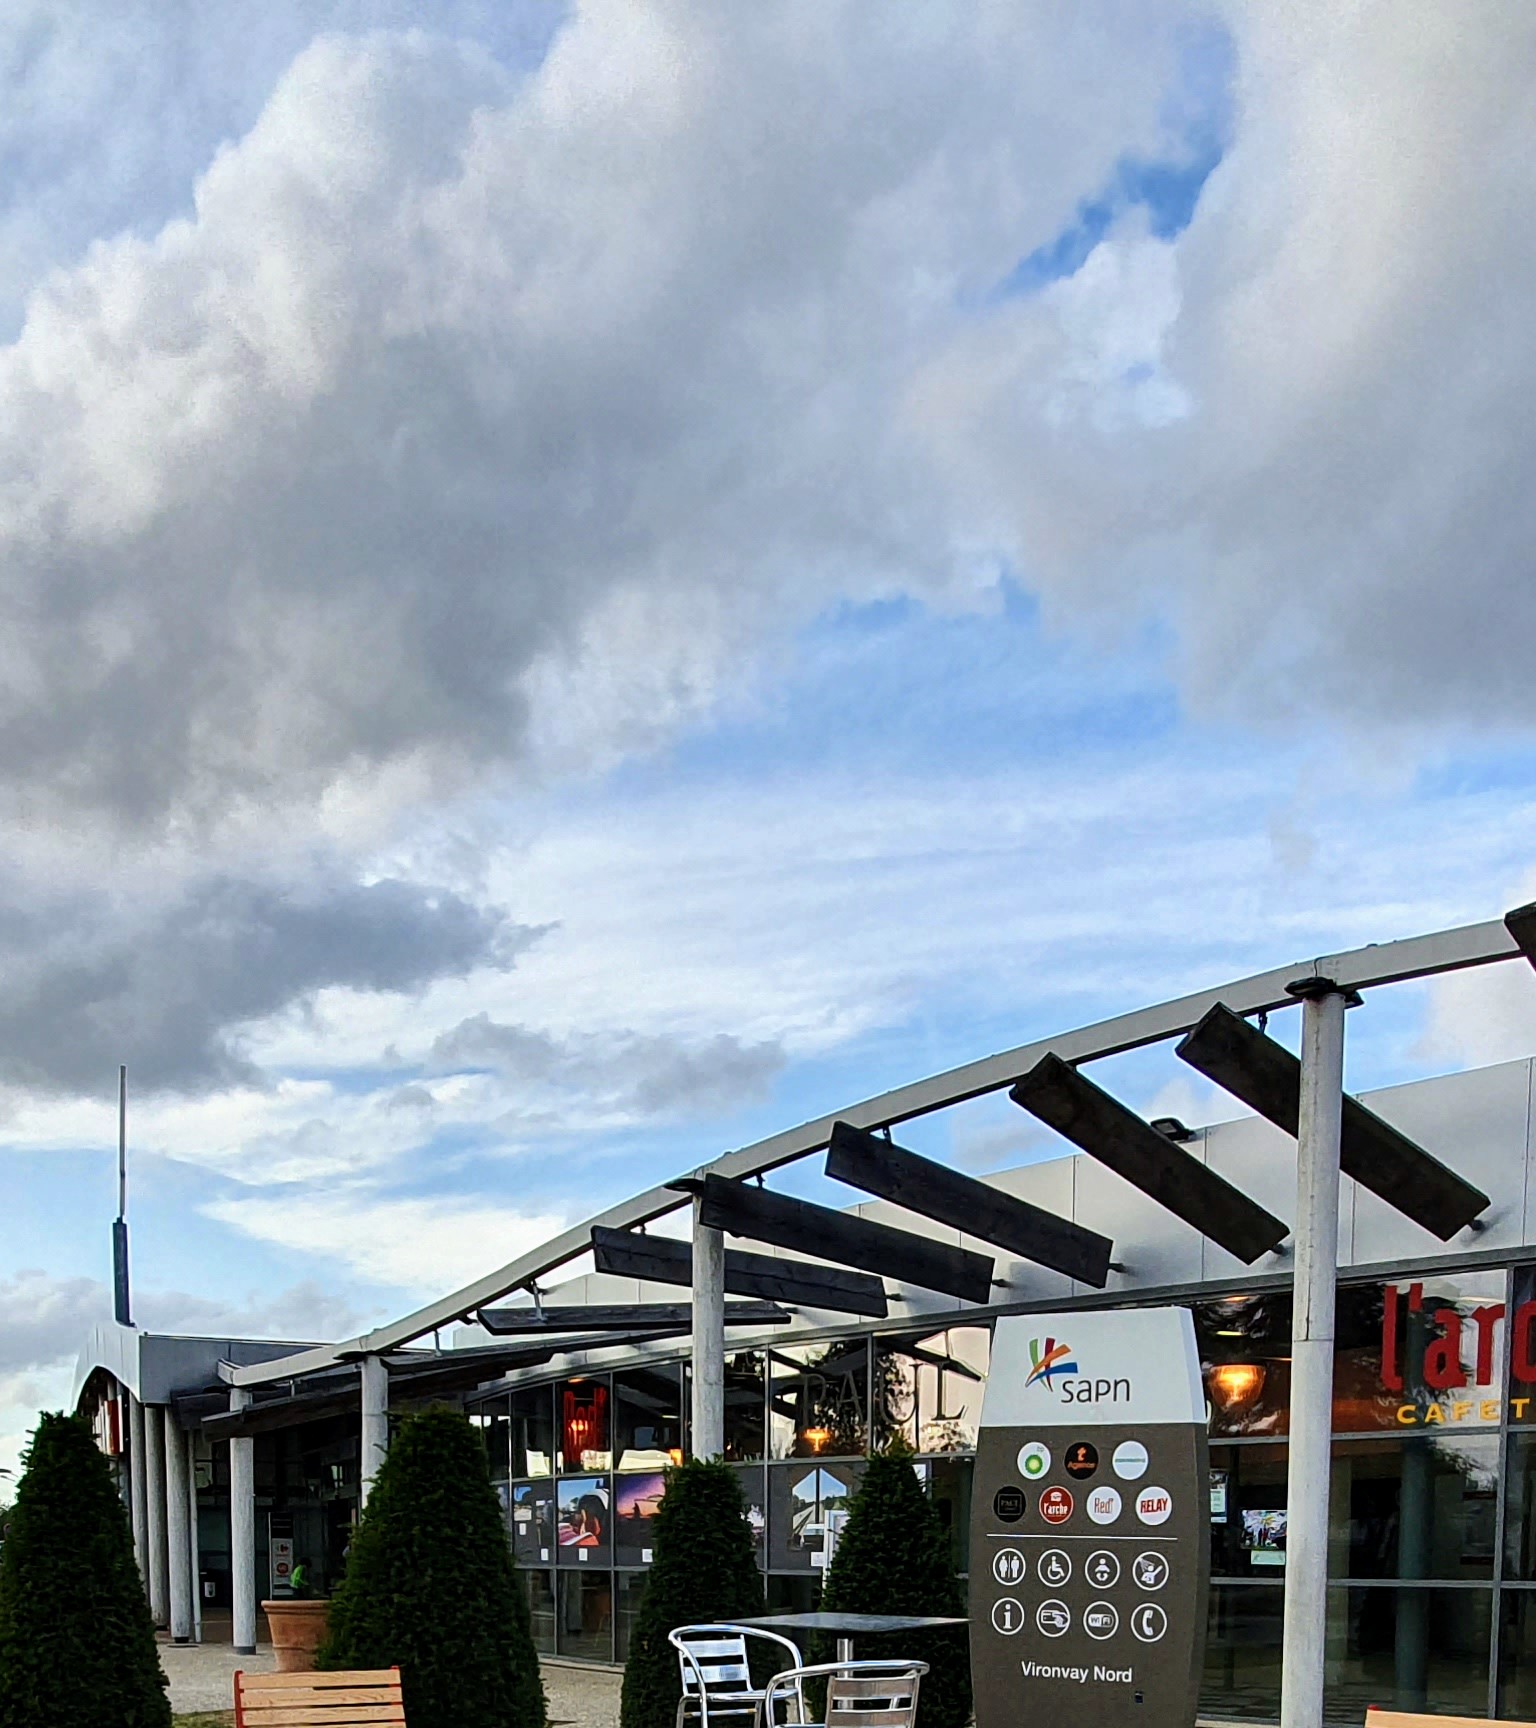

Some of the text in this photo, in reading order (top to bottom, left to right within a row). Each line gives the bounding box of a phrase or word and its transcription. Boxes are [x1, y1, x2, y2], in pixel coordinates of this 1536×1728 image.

[1061, 1379, 1130, 1403] sapn
[1140, 1497, 1168, 1514] RELAY
[1021, 1661, 1132, 1683] Vironvay Nord
